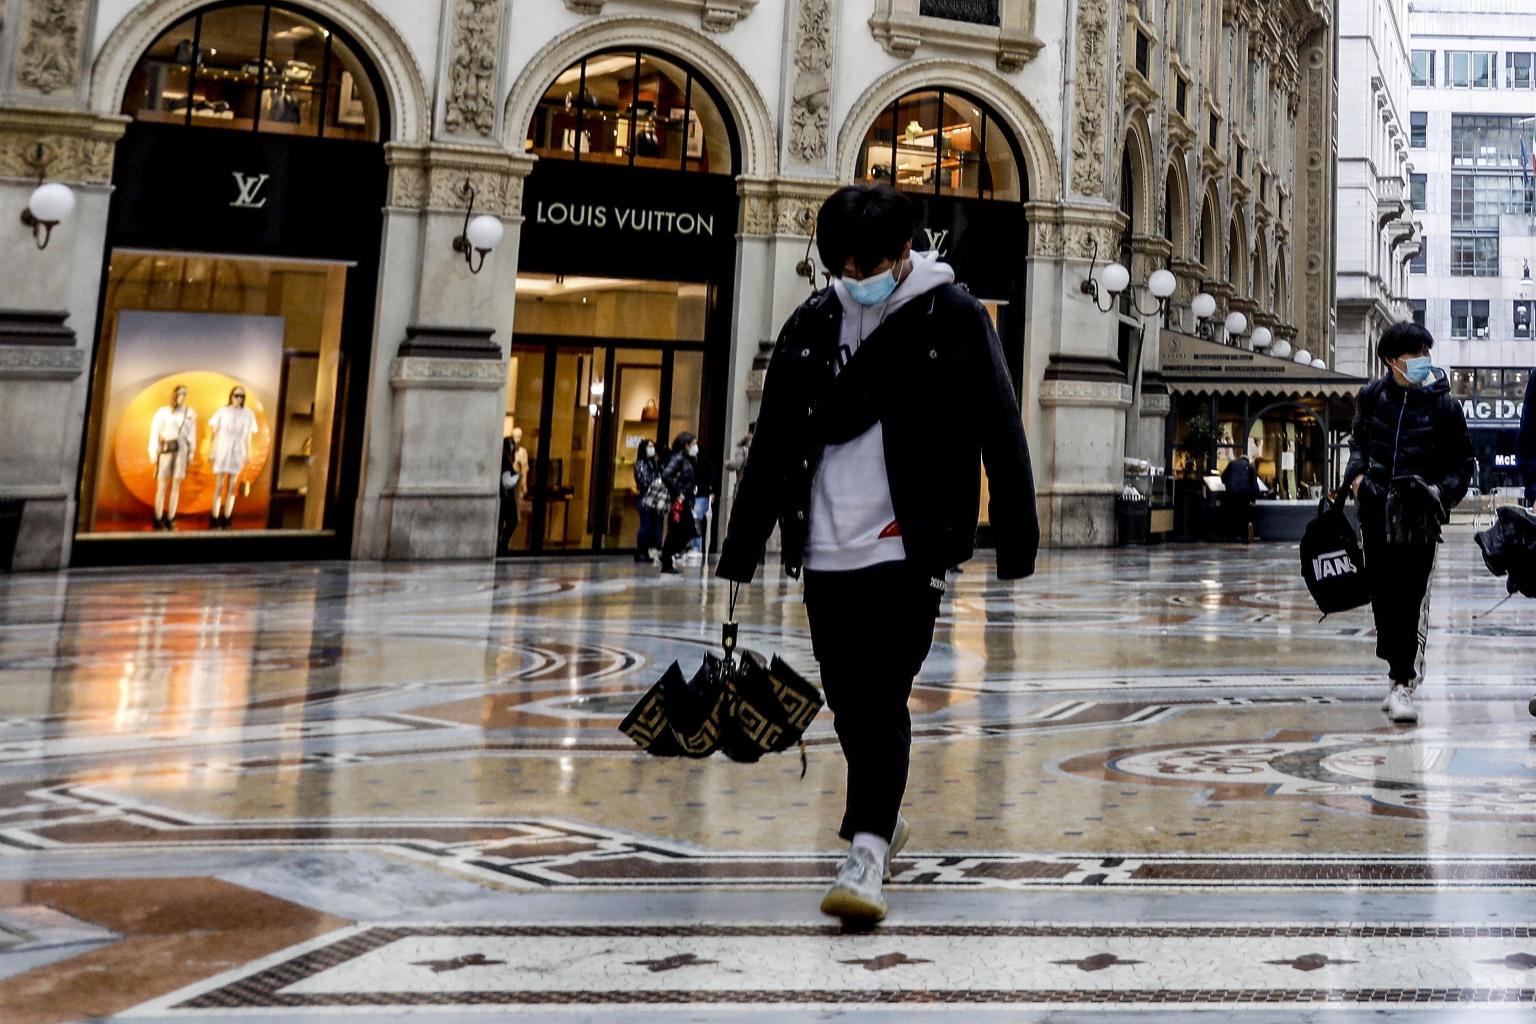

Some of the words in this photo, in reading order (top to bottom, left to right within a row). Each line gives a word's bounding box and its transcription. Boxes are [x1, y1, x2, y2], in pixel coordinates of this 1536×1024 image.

[536, 201, 607, 227] LOUIS
[614, 207, 714, 236] VUITTON
[1312, 549, 1357, 582] VANS
